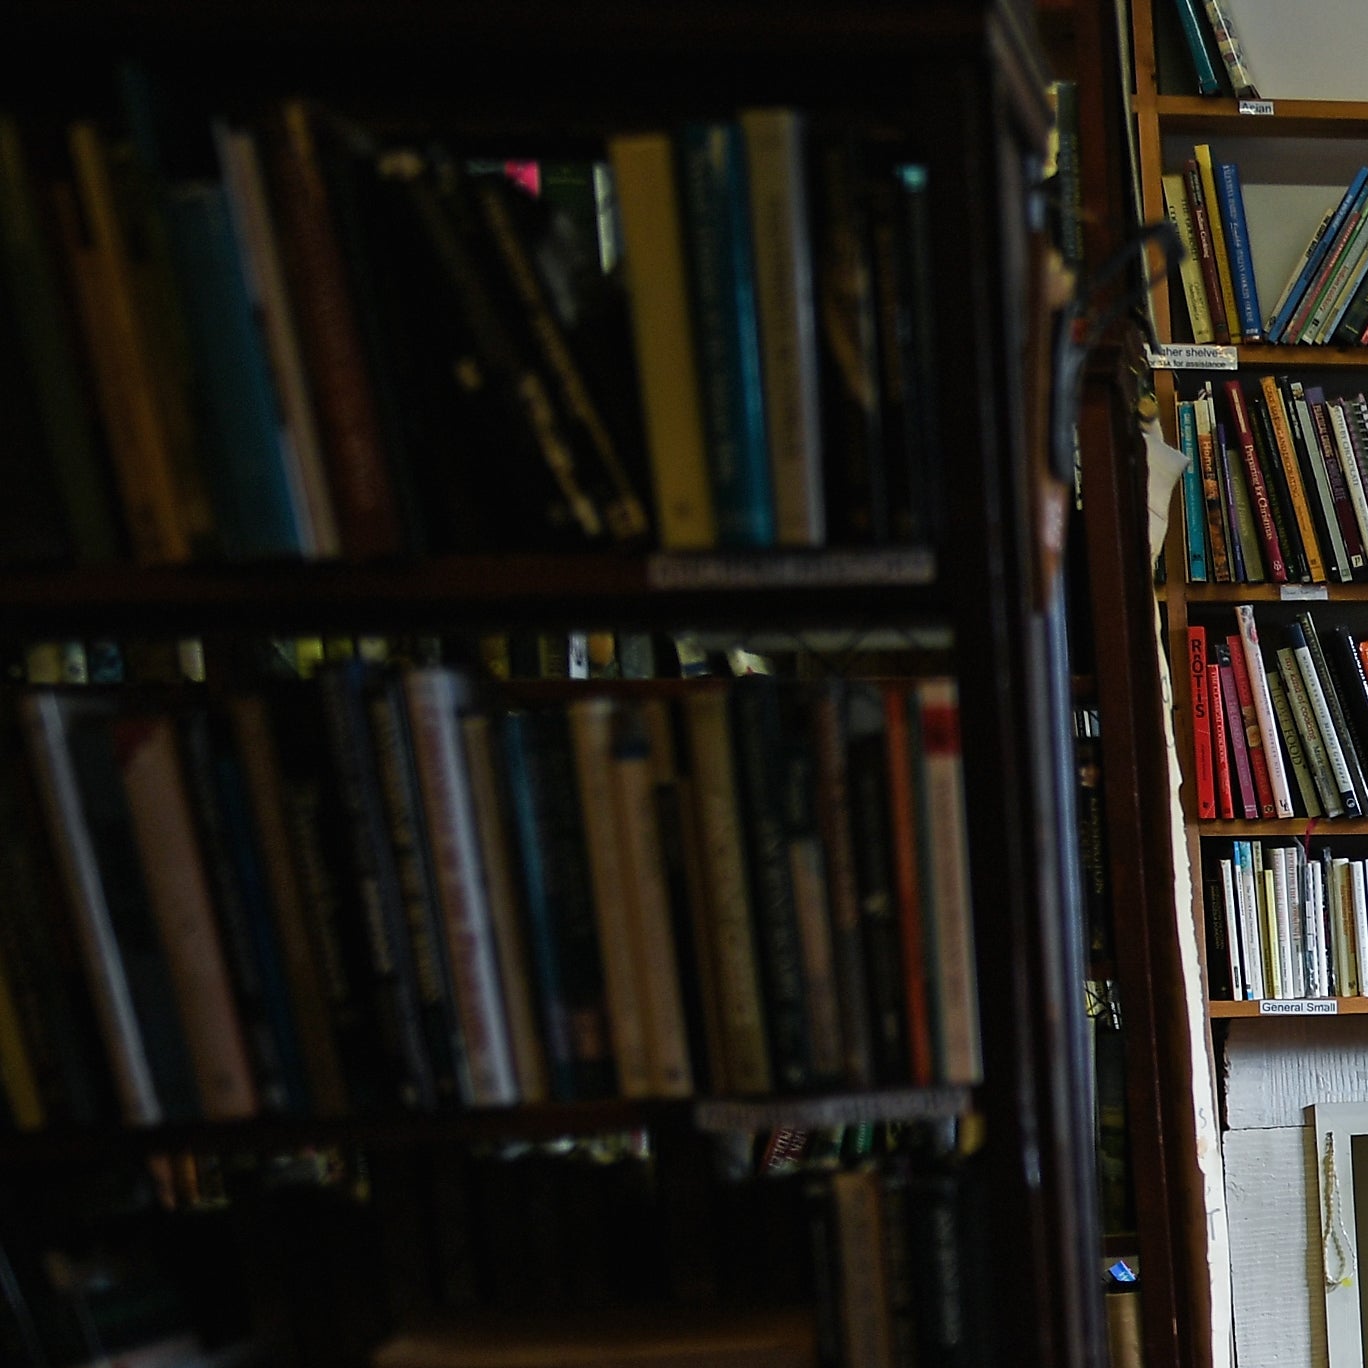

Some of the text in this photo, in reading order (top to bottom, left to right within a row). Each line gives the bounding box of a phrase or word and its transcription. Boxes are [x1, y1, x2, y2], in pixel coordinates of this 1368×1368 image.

[1195, 208, 1211, 258] Indian Cooking
[1200, 440, 1217, 472] Home
[1241, 442, 1276, 541] Preparing for Christmas
[1283, 655, 1316, 741] my kind of cooking
[1262, 1002, 1336, 1013] General Small
